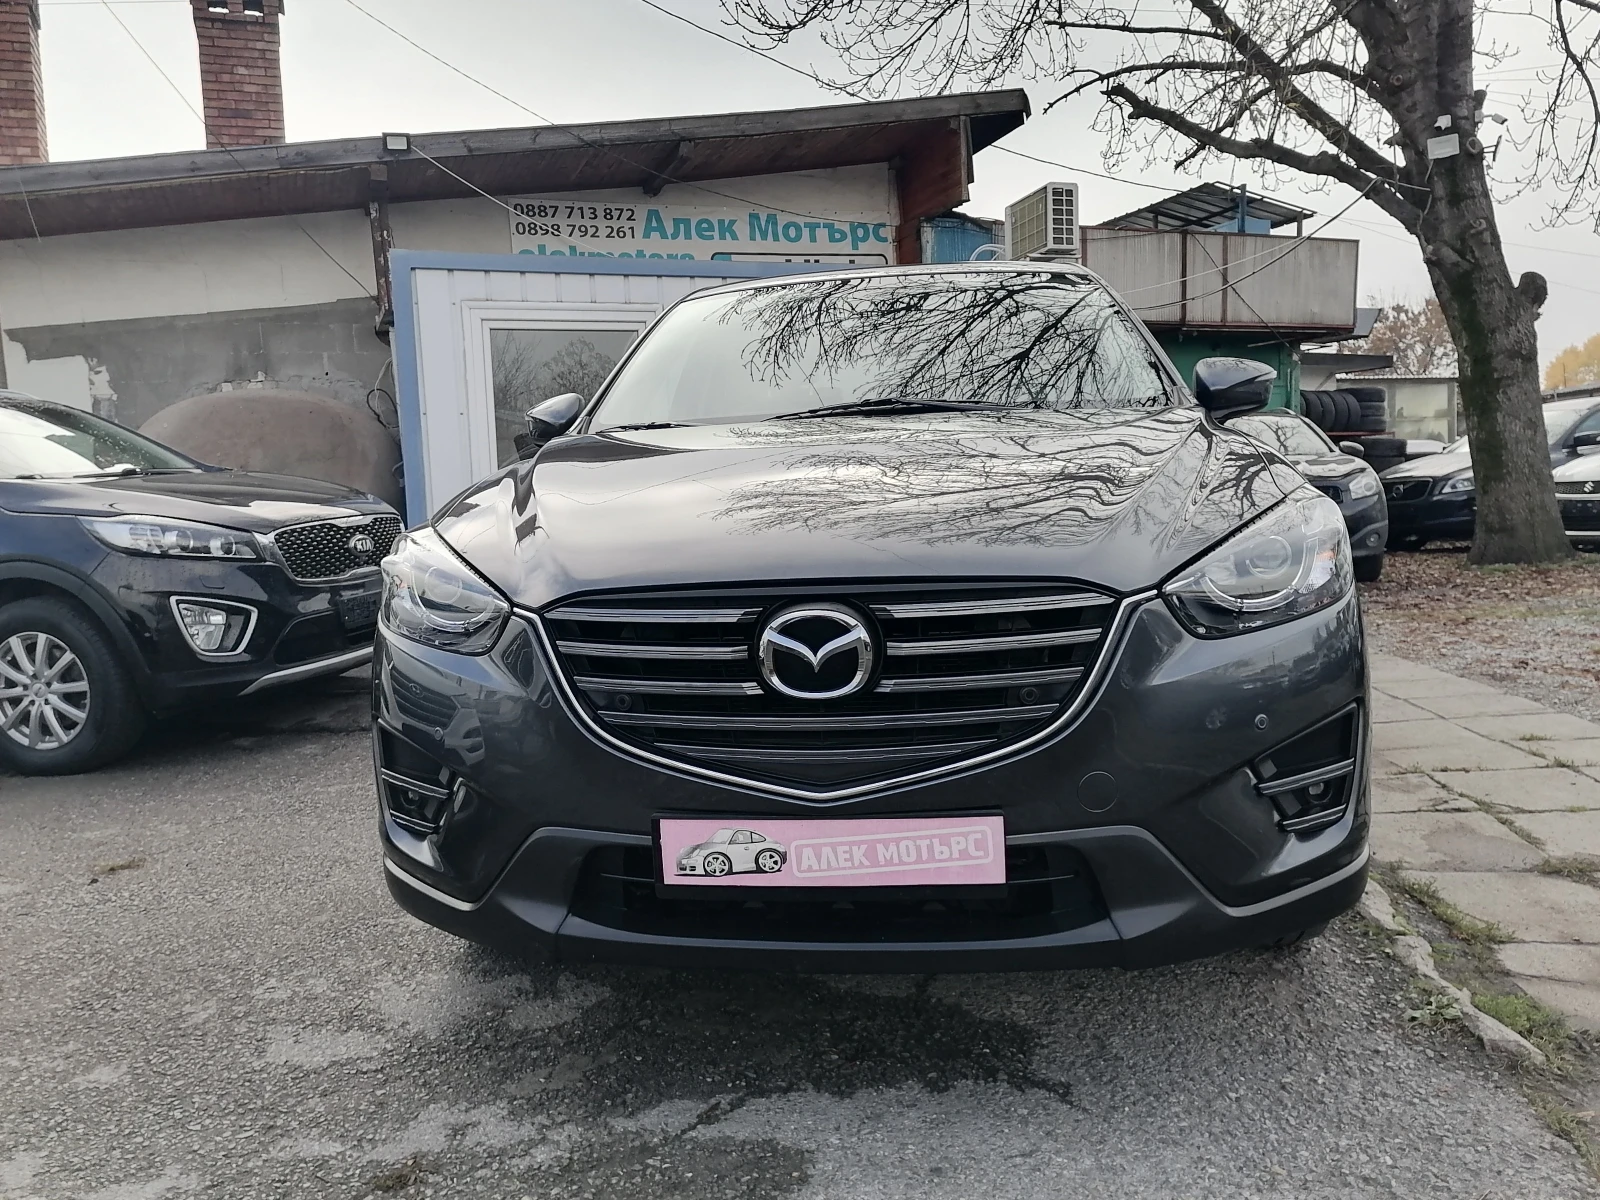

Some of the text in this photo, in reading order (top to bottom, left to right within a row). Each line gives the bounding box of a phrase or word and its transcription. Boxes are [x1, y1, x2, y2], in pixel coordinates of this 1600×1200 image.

[513, 203, 636, 221] 0887 713 872
[515, 222, 636, 239] 0898 792 261
[642, 208, 888, 251] Алек Мотърс
[356, 539, 373, 552] KIA
[800, 844, 870, 871] АЛЕК
